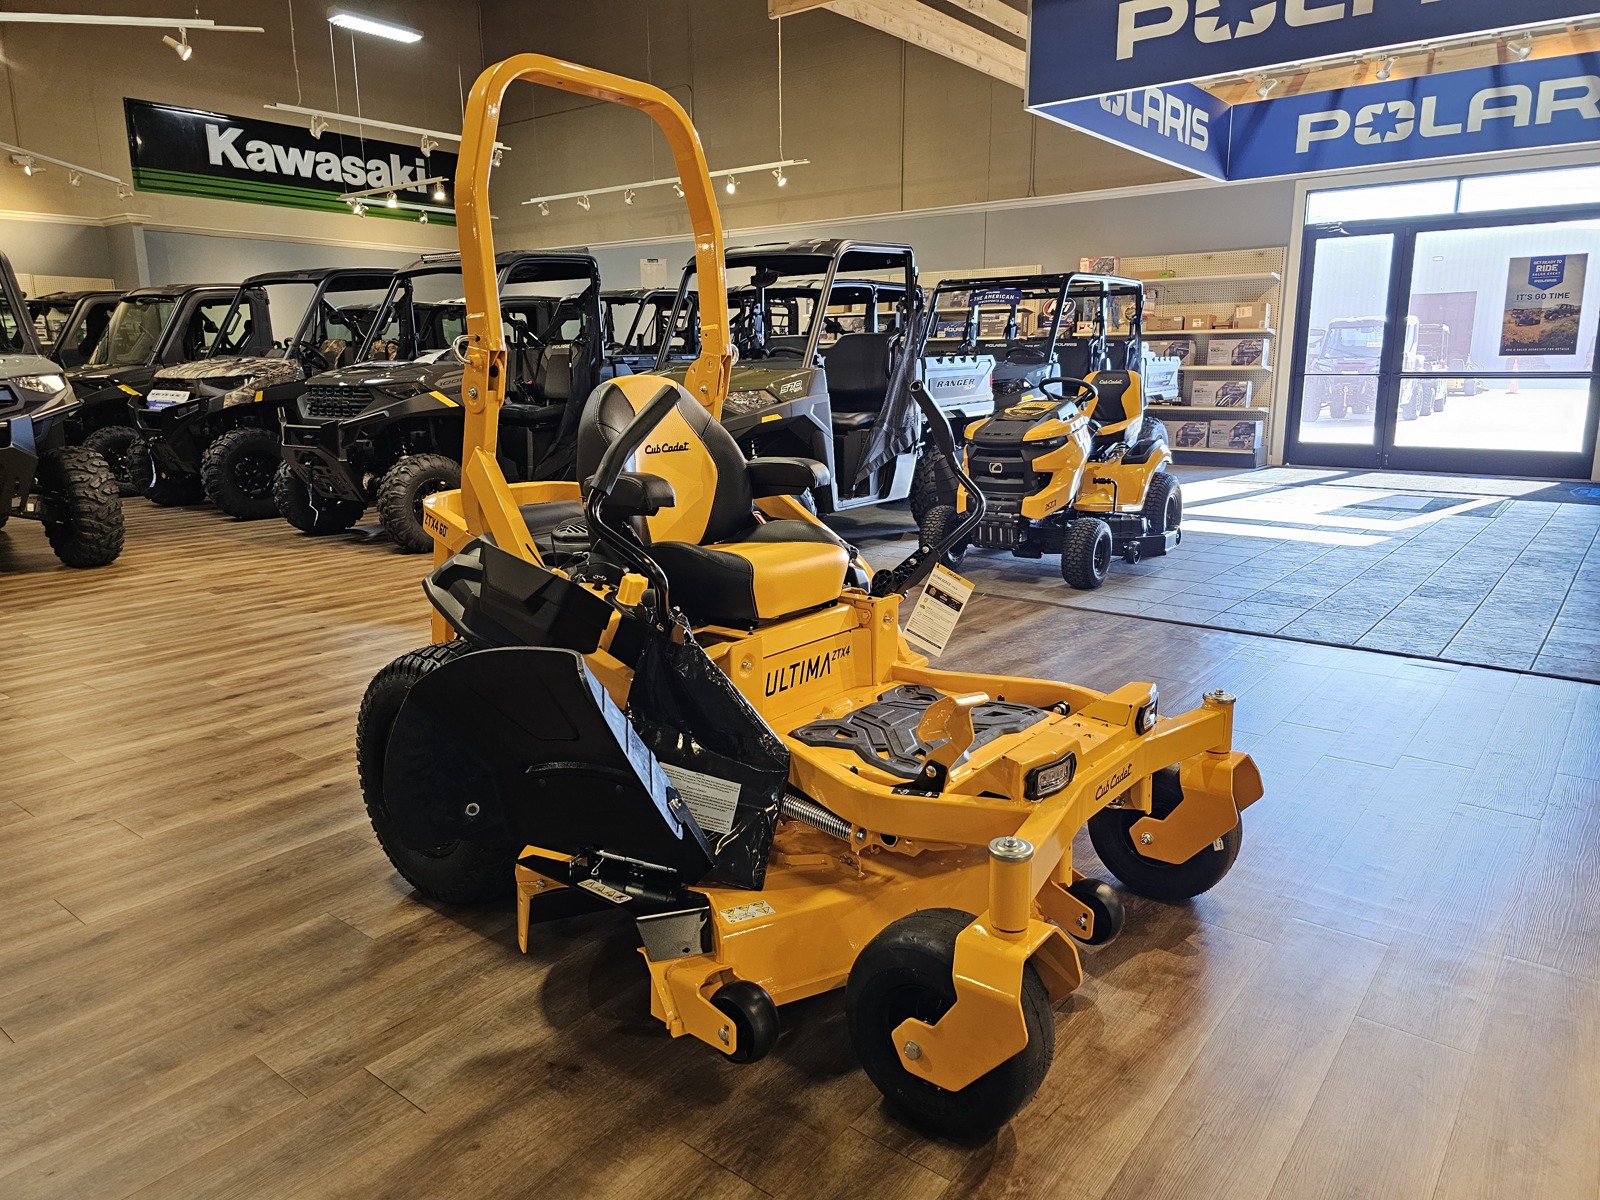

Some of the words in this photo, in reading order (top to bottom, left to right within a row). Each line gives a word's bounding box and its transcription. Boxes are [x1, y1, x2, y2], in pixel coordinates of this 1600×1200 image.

[205, 123, 428, 194] Kawasaki
[1535, 264, 1559, 273] RIDE
[1516, 293, 1533, 301] IT'S
[1549, 292, 1570, 300] TIME
[936, 378, 975, 388] RANGER
[644, 444, 661, 455] Cub
[661, 441, 690, 453] Cadet
[424, 512, 439, 532] ZTX4
[439, 522, 449, 538] 60
[765, 652, 831, 697] ULTIMA
[831, 645, 851, 661] ZTX4
[1095, 777, 1111, 801] Cub
[1110, 763, 1133, 790] Cadet
